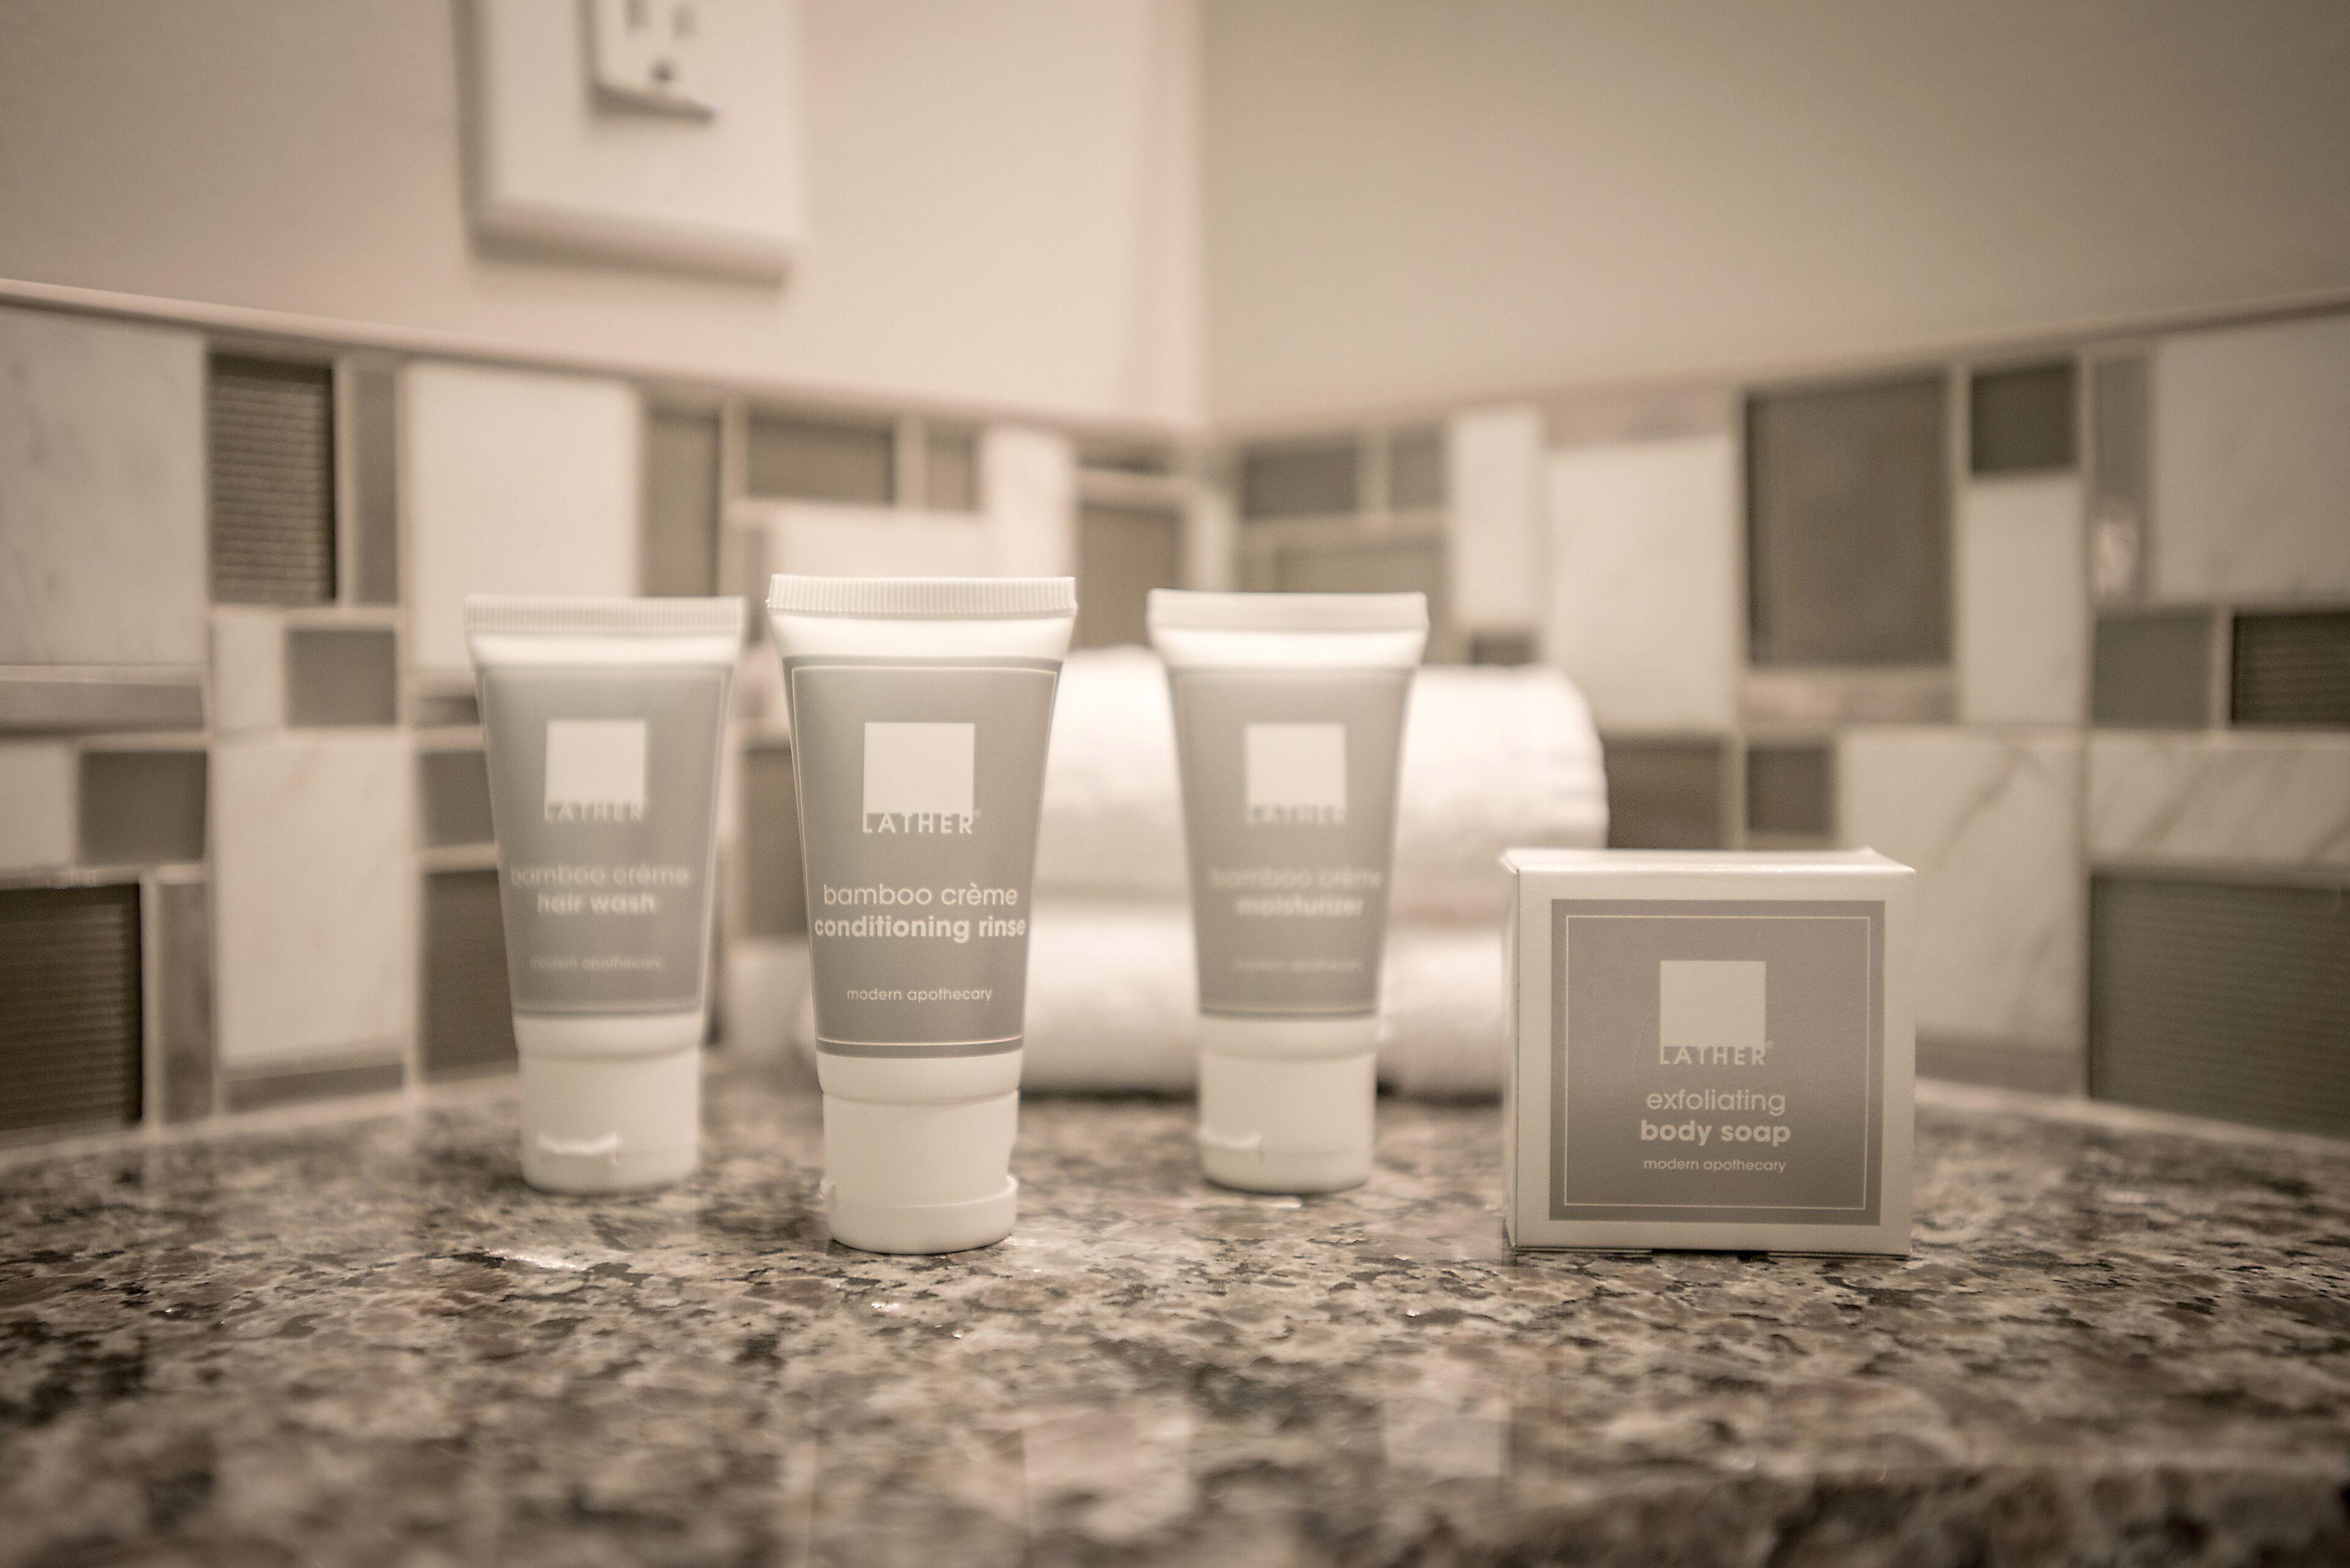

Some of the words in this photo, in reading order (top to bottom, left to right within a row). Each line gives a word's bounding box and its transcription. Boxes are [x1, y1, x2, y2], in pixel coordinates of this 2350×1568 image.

[862, 812, 973, 834] LATHER
[510, 864, 606, 885] bamboo
[537, 892, 583, 914] hair
[589, 892, 656, 914] wash
[824, 883, 932, 905] bamboo
[941, 883, 1018, 905] crème
[815, 916, 970, 944] conditioning
[979, 916, 1026, 937] rinse
[847, 988, 902, 1001] modern
[907, 988, 993, 1003] apothecary
[1659, 1046, 1766, 1066] LATHER
[1646, 1089, 1786, 1116] exfoliating
[1641, 1120, 1713, 1146] body
[1721, 1125, 1791, 1147] soap
[1644, 1159, 1699, 1170] modern
[1703, 1159, 1787, 1174] apothecary
